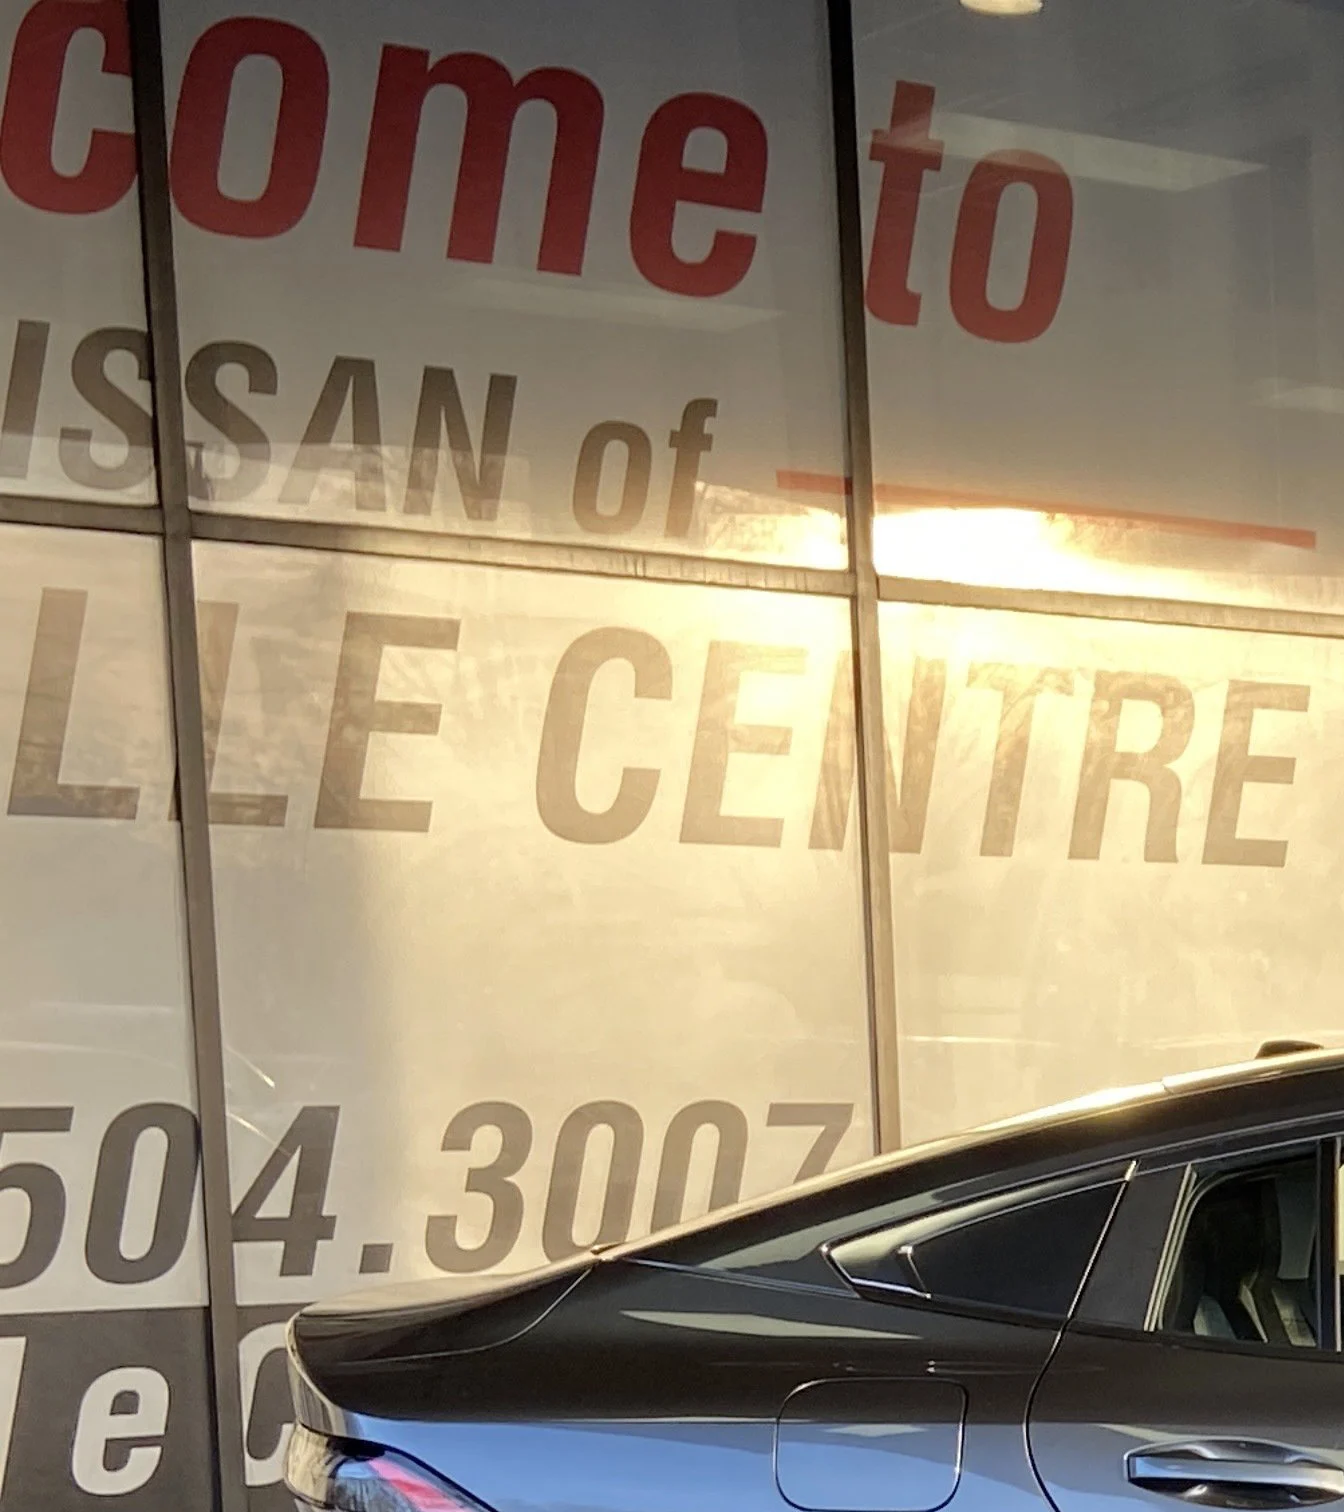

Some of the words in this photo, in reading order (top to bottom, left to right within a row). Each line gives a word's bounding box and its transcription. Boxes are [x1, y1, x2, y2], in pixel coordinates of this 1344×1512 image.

[863, 80, 1075, 345] to
[1, 318, 518, 523] ISSAN
[570, 399, 718, 539] of
[535, 625, 1311, 869] CENTRE
[0, 1099, 855, 1290] 504.3007
